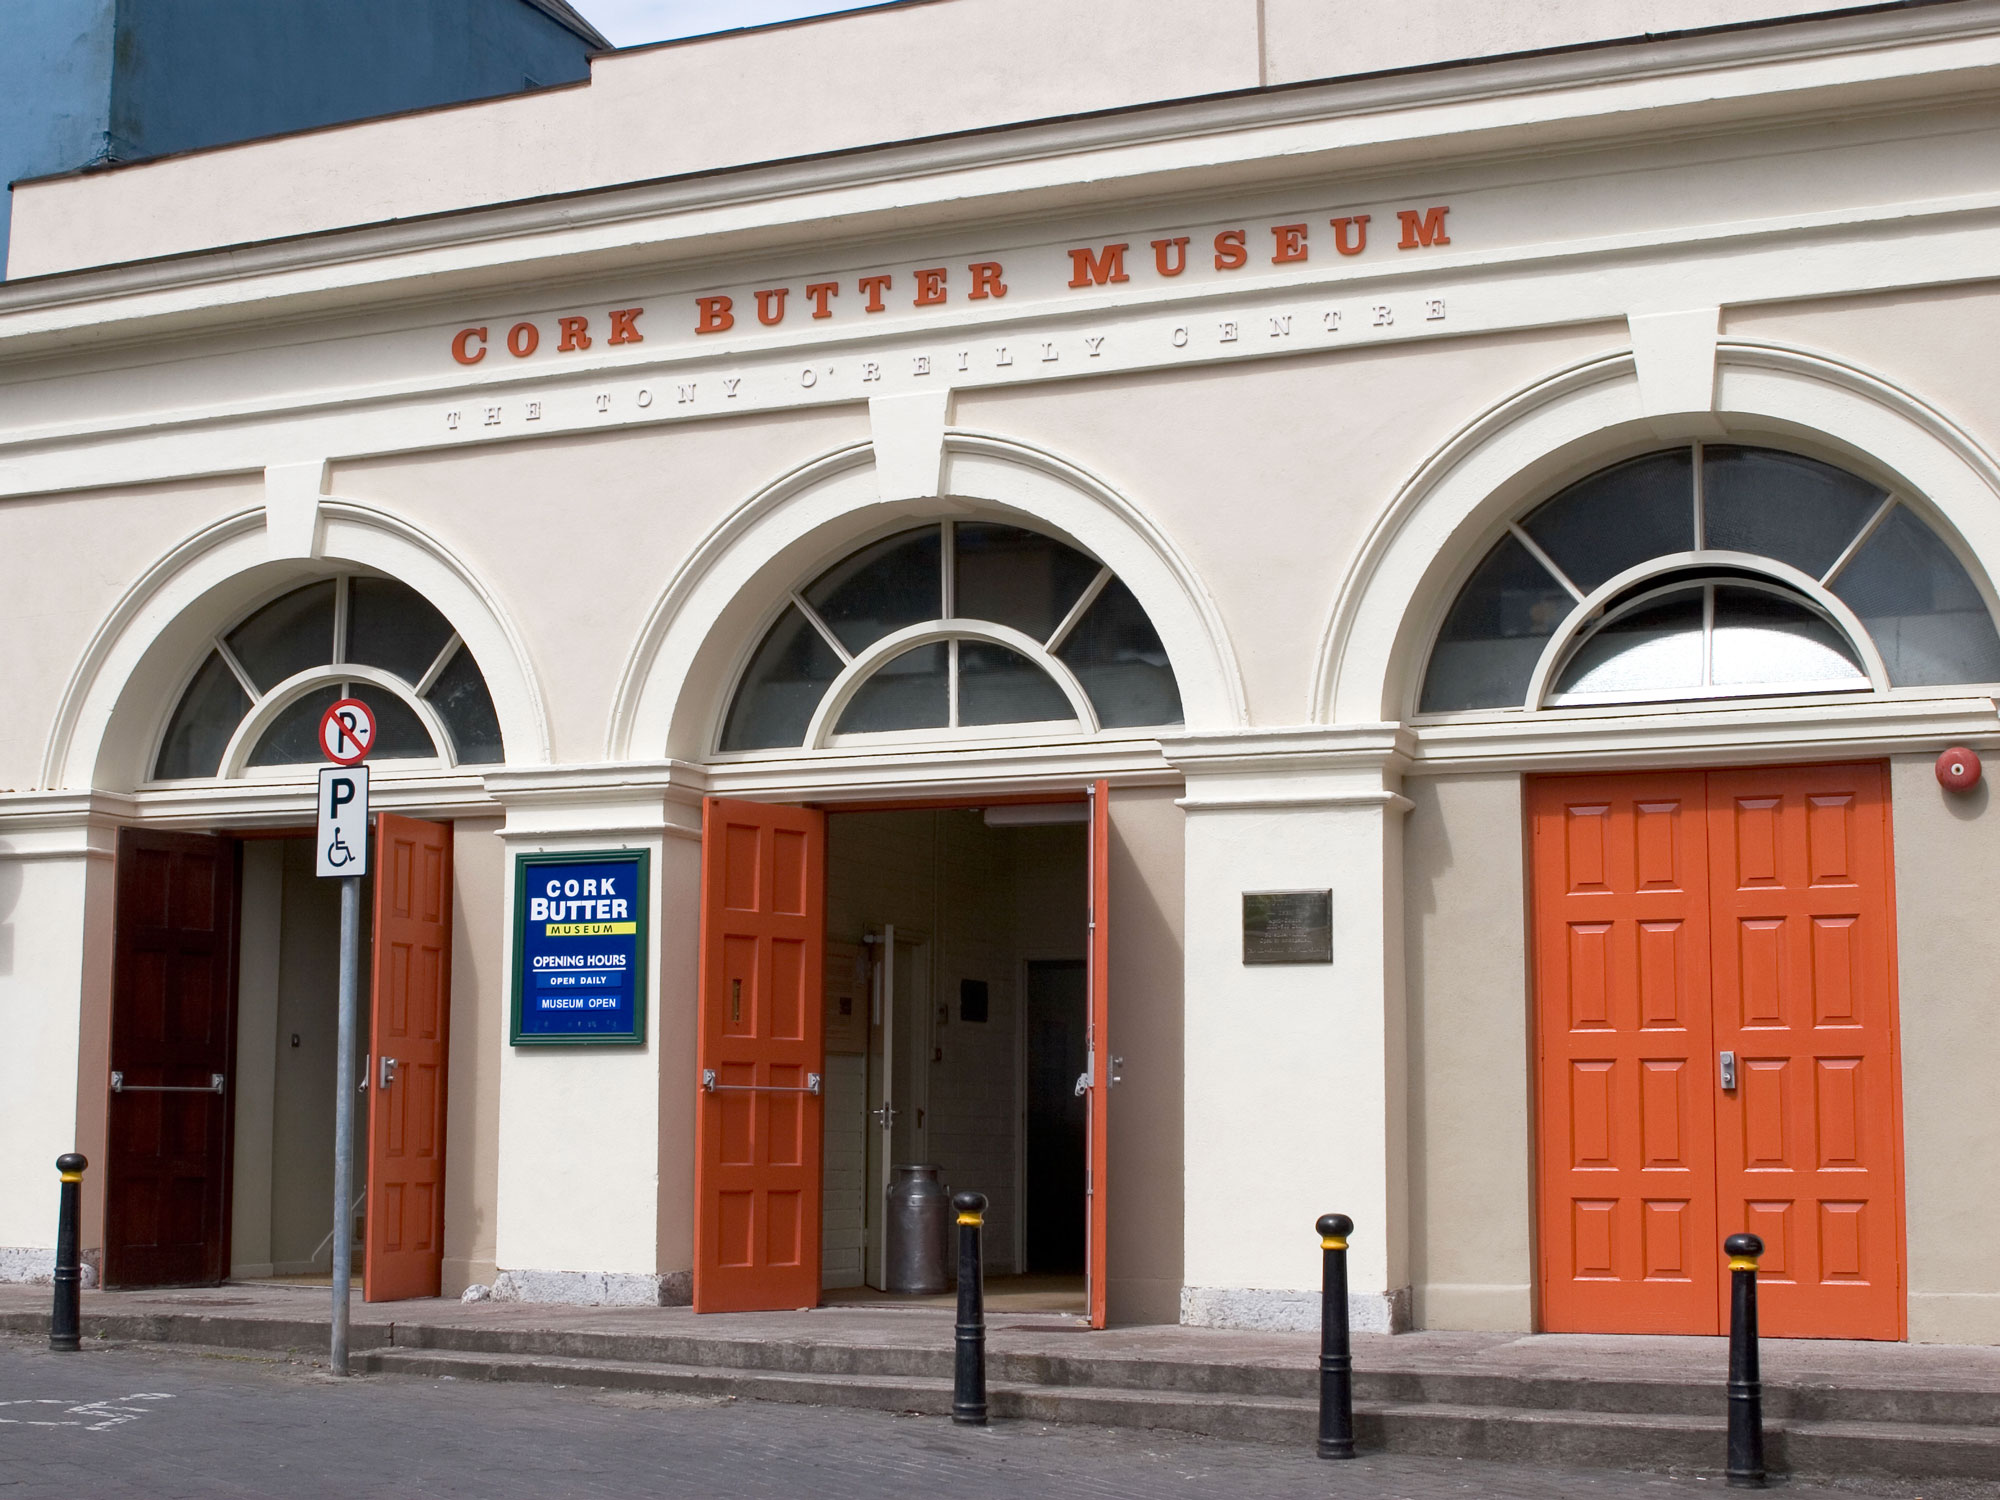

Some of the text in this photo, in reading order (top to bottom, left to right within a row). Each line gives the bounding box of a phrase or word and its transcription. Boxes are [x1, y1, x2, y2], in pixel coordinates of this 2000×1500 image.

[452, 206, 1451, 365] CORK BUTTER MUSEUM
[446, 298, 1446, 429] THE TONY O'REILLY CENTRE
[330, 778, 356, 819] P
[546, 878, 616, 898] CORK
[530, 897, 628, 921] BUTTER
[551, 924, 614, 935] MUSEUM
[533, 954, 626, 967] OPENING HOURS
[550, 976, 607, 985] OPEN DAILY
[541, 998, 616, 1009] MUSEUM OPEN
